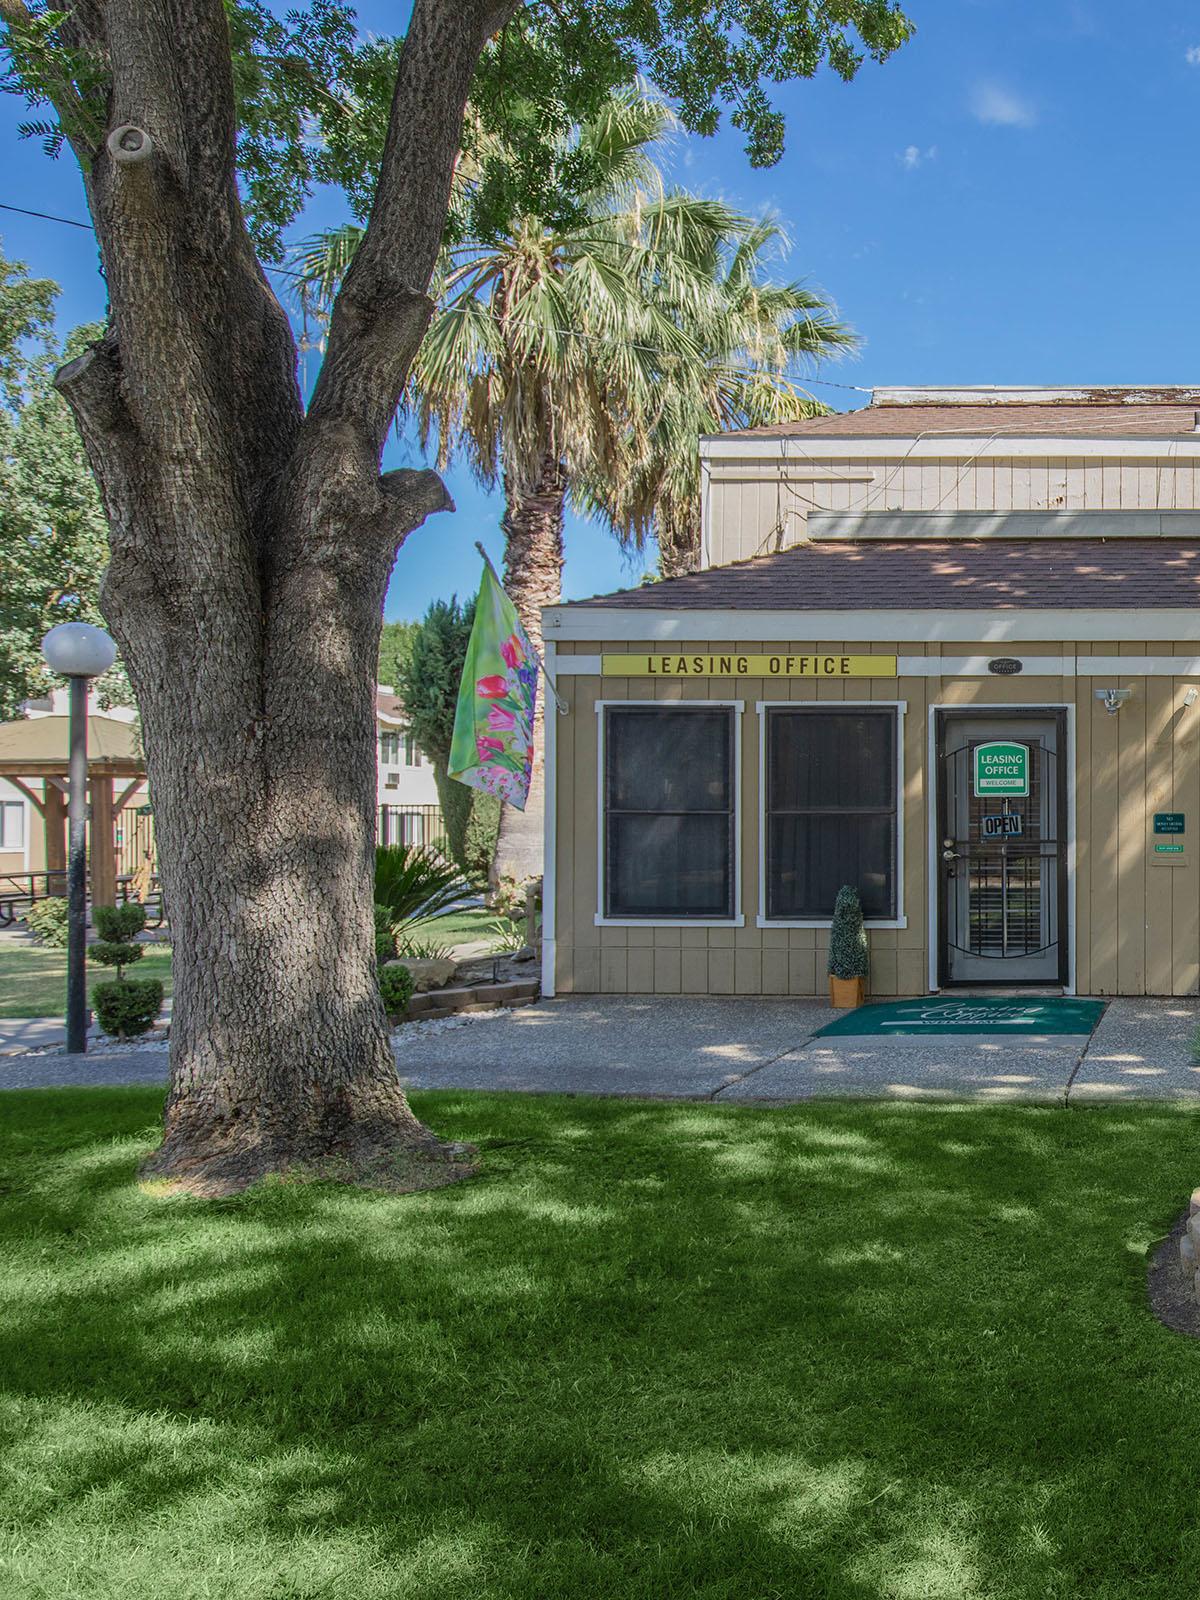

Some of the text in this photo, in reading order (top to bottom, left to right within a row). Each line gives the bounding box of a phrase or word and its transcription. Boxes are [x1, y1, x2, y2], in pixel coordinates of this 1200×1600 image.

[648, 657, 850, 674] LEASING OFFICE
[981, 755, 1023, 764] LEASING
[984, 766, 1019, 775] OFFICE
[985, 816, 1019, 834] OPEN
